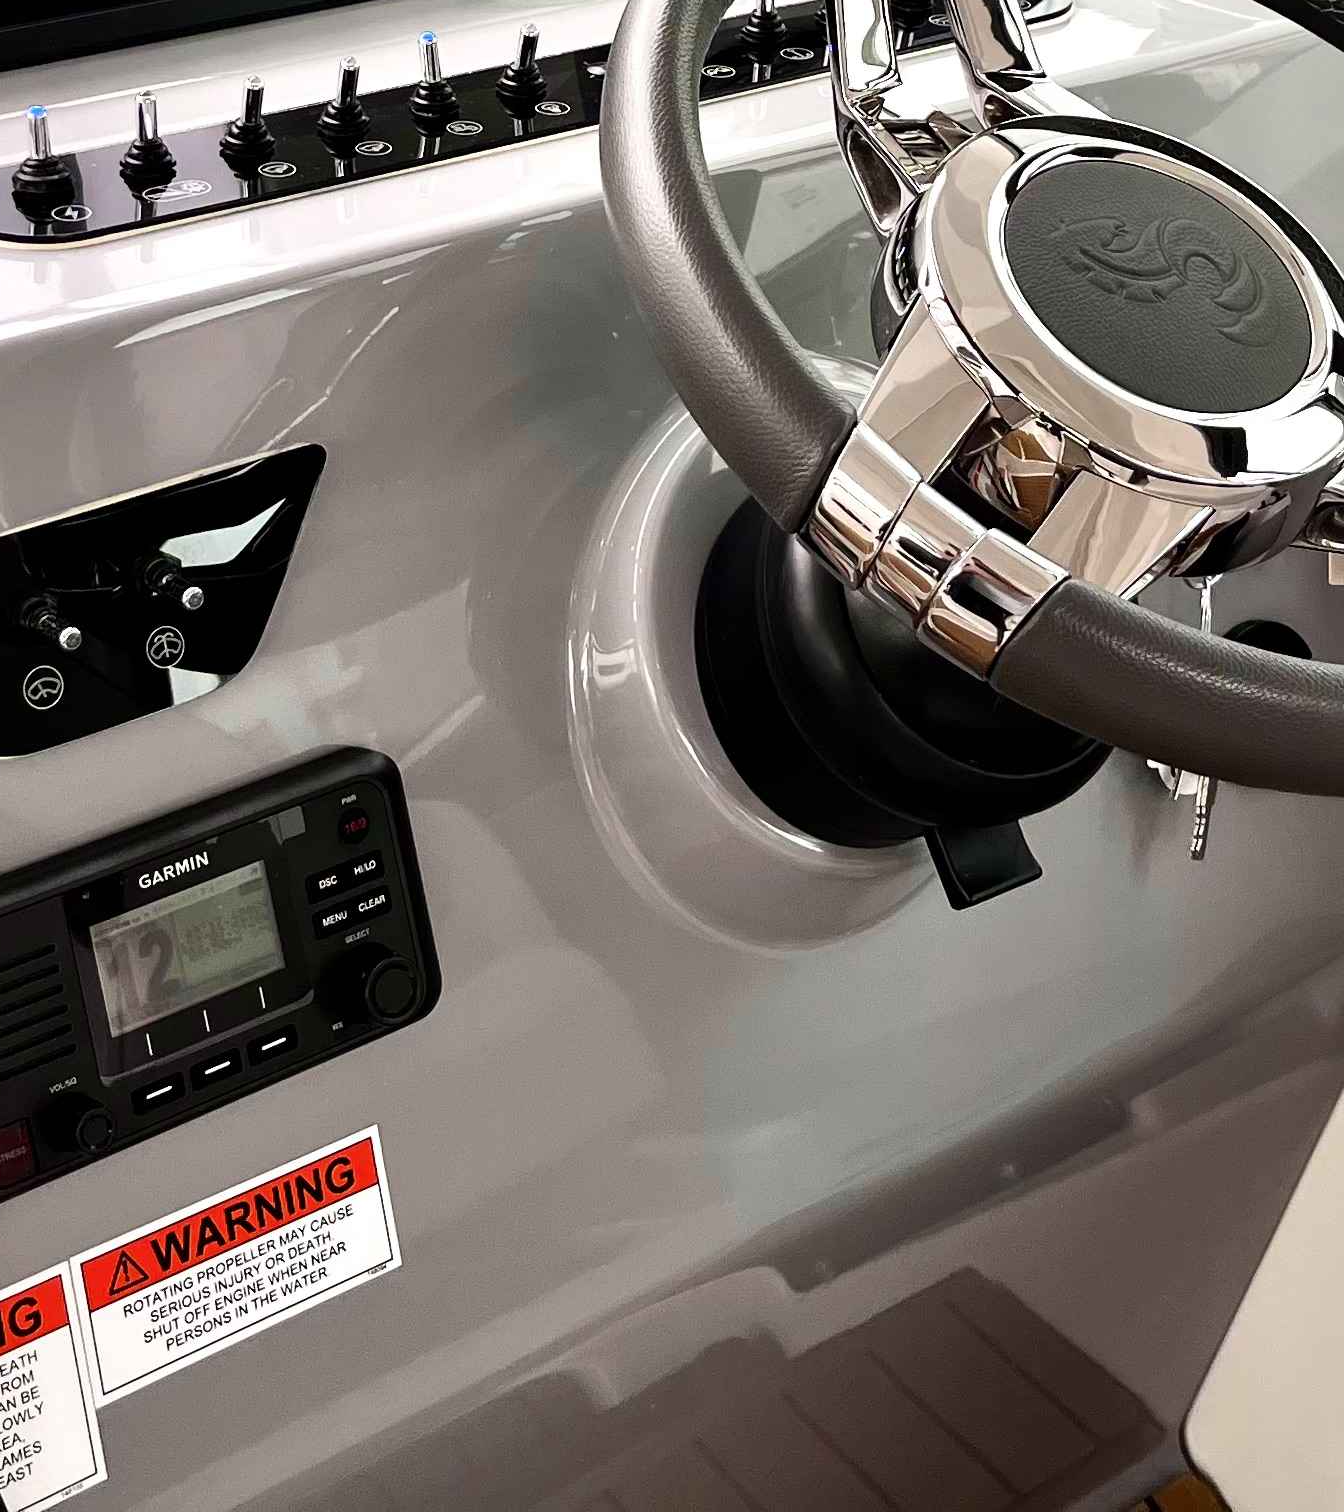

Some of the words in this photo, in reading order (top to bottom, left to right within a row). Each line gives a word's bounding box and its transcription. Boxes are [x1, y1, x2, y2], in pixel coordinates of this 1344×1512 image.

[138, 850, 210, 890] GARMIN
[318, 875, 338, 890] DSC
[322, 910, 348, 927] MENU
[358, 894, 386, 913] CLEAR
[344, 927, 371, 944] SELECT
[150, 1156, 355, 1272] WARNING
[123, 1277, 194, 1318] ROTATING
[197, 1239, 276, 1284] PROPELLER
[279, 1226, 307, 1248] MAY
[310, 1203, 354, 1232] CAUSE
[143, 1317, 180, 1344] SHUT
[184, 1303, 211, 1325] OFF
[214, 1281, 267, 1311] ENGINE
[268, 1261, 309, 1290] WHEN
[311, 1241, 347, 1268] NEAR
[150, 1287, 211, 1323] SERIOUS
[214, 1264, 263, 1295] INJURY
[265, 1254, 285, 1273] OR
[166, 1311, 232, 1351] PERSONS
[236, 1303, 249, 1319] IN
[254, 1289, 278, 1311] THE
[21, 1385, 42, 1404] BE
